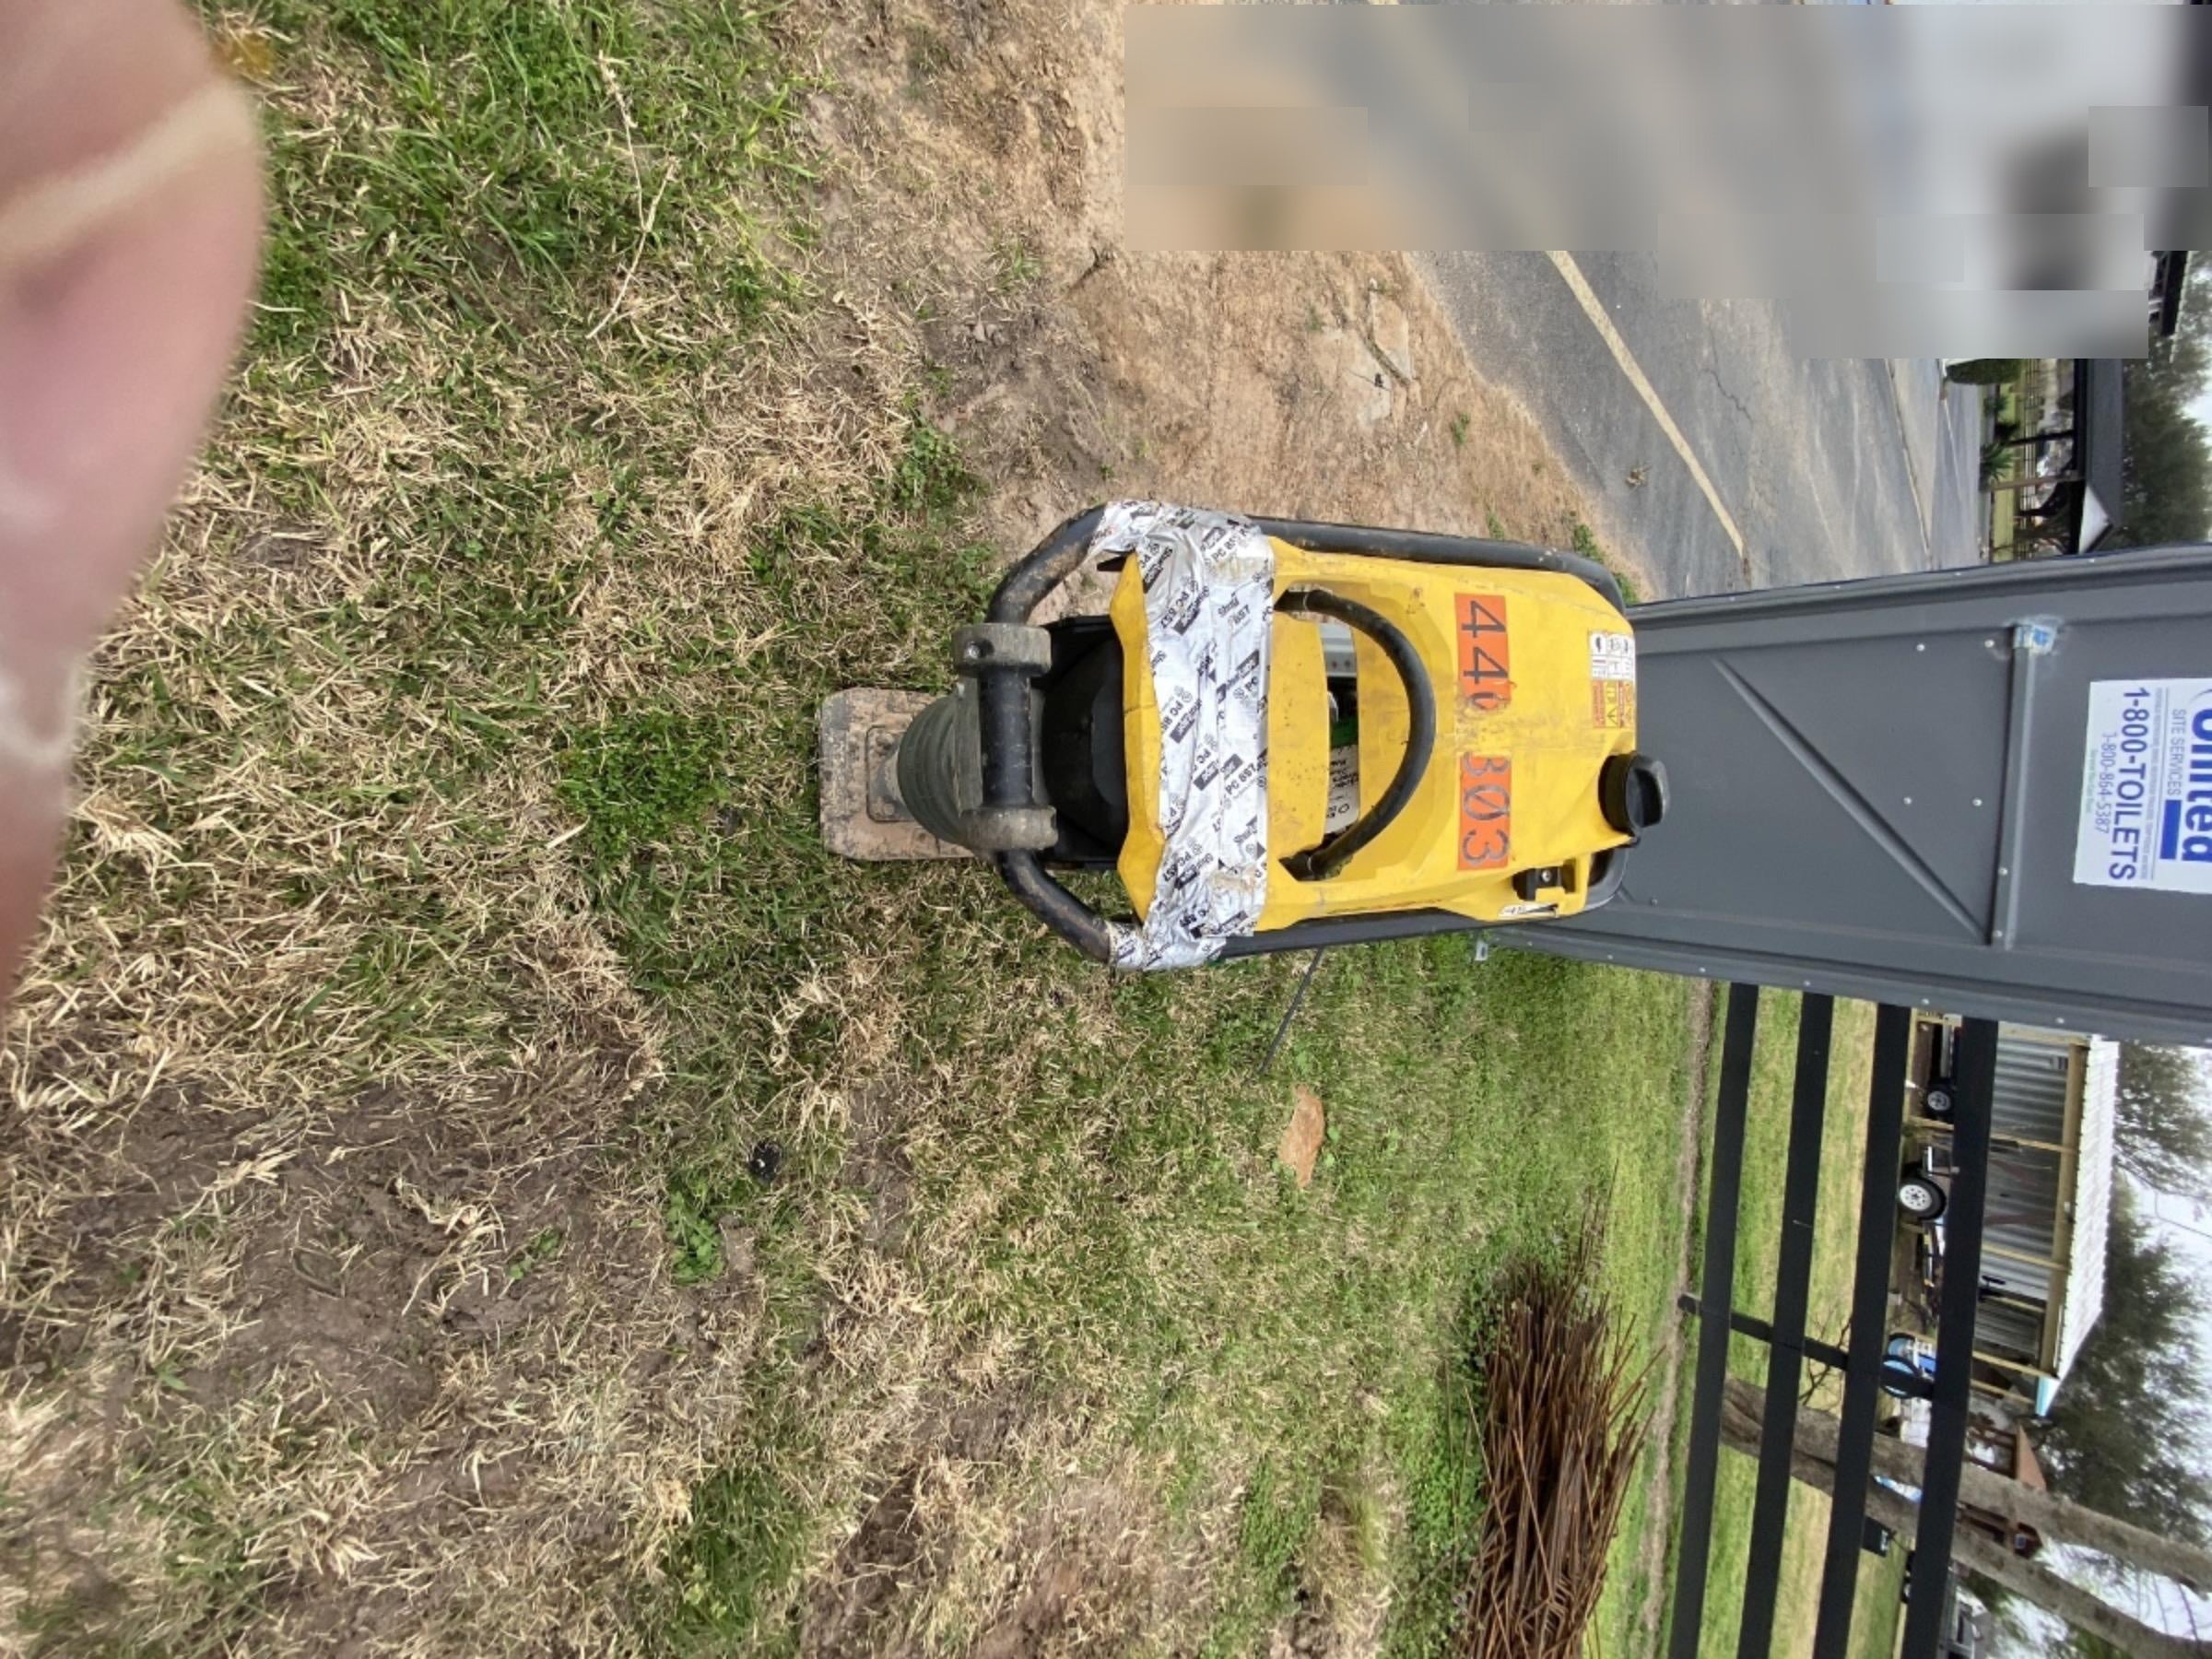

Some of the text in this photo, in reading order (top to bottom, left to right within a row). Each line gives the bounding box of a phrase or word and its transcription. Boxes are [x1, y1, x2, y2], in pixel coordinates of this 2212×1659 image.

[1175, 592, 1189, 606] PC
[1171, 700, 1183, 715] PC
[1196, 748, 1212, 764] PC
[2167, 709, 2186, 795] SITE SERVICES
[1226, 779, 1243, 795] PC
[2109, 688, 2150, 880] 1-800-TOILETS
